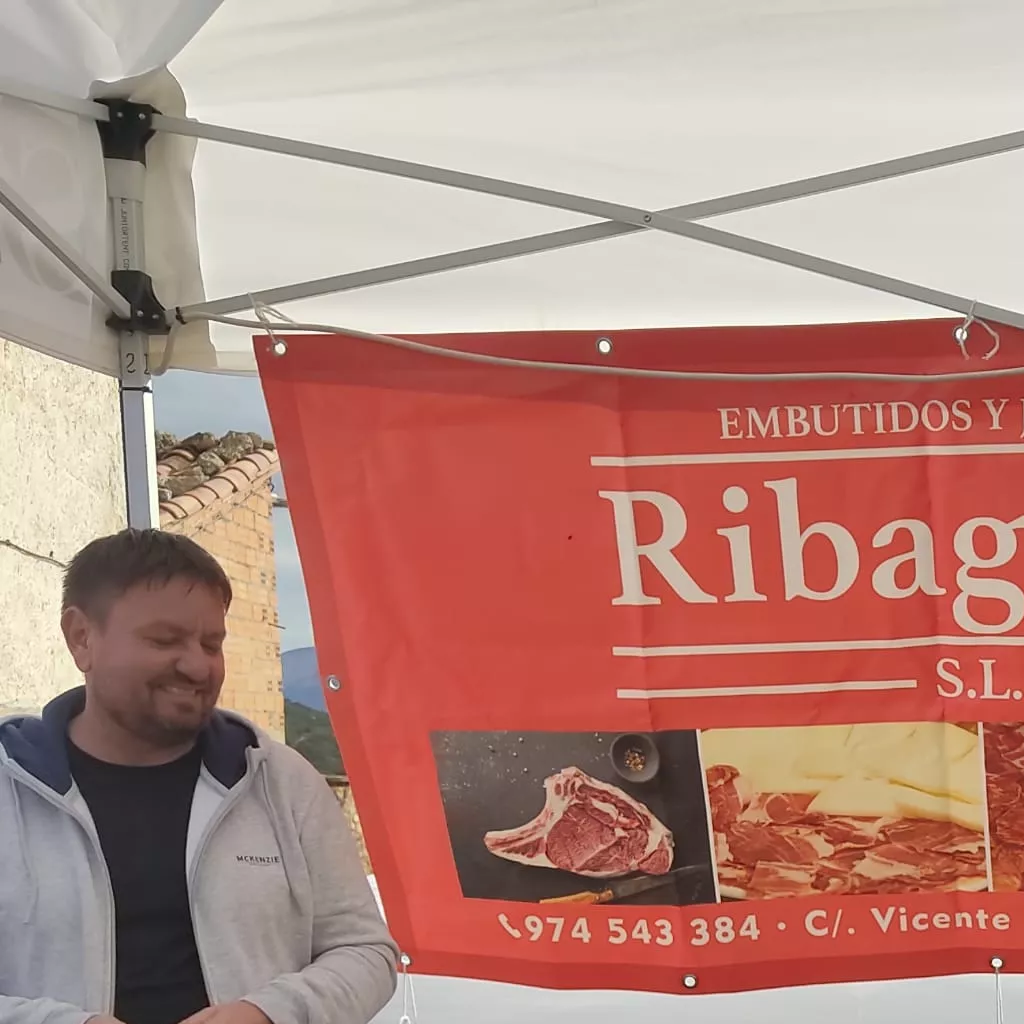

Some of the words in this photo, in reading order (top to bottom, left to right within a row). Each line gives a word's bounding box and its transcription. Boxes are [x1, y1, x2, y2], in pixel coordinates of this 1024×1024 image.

[717, 399, 972, 440] EMBUTIDOS
[983, 398, 1009, 430] Y
[935, 658, 1023, 700] S.L.
[524, 914, 592, 944] 974
[607, 917, 673, 946] 543
[690, 914, 760, 946] 384
[804, 908, 855, 938] C/.
[870, 906, 1010, 934] Vicente
